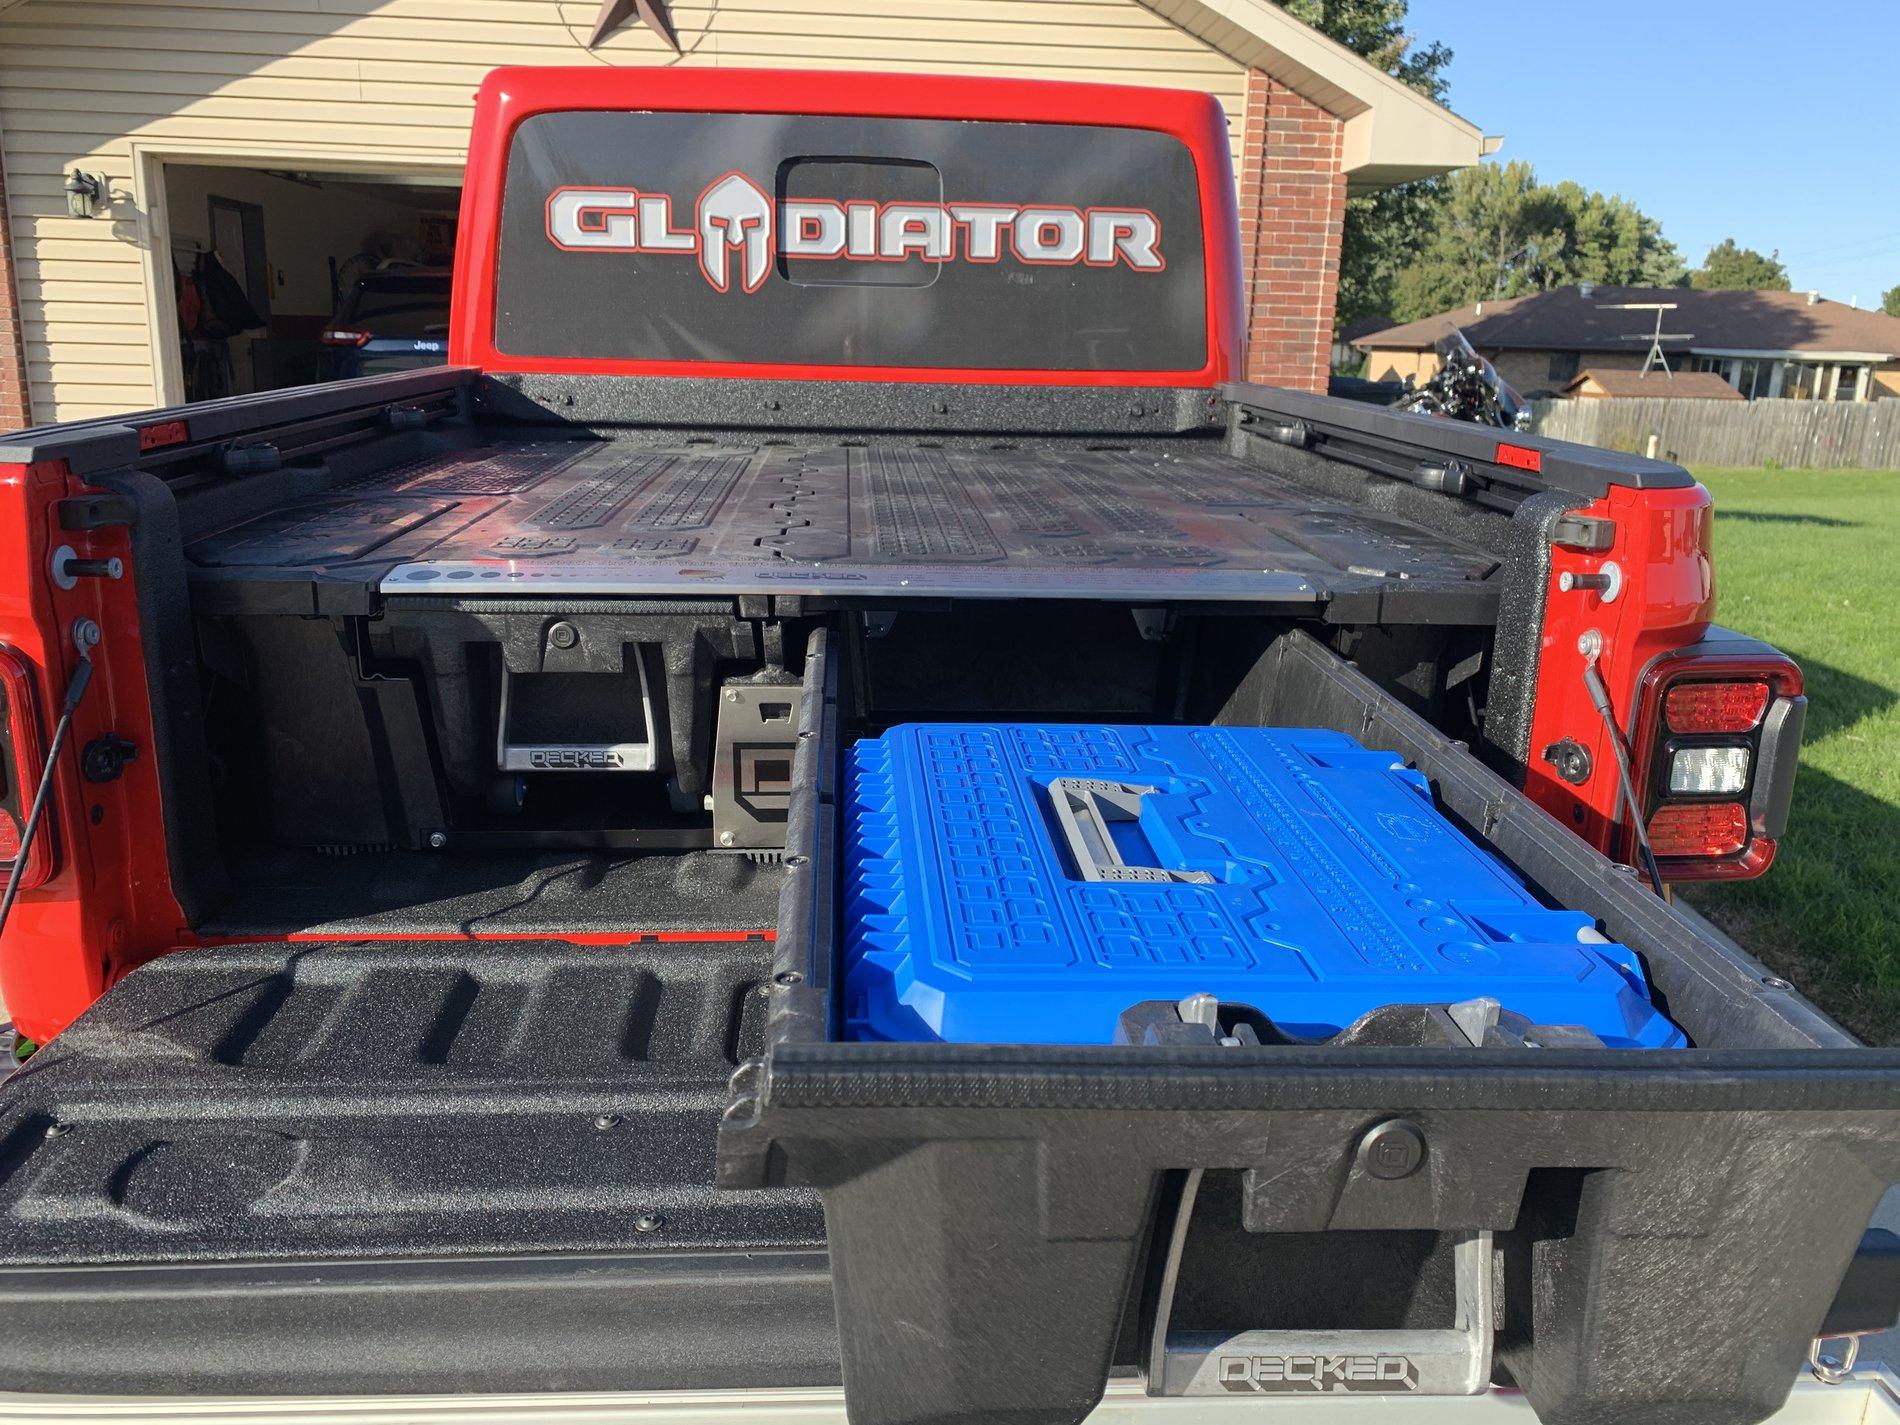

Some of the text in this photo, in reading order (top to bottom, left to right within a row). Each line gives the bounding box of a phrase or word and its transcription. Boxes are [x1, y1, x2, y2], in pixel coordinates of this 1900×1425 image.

[413, 340, 439, 351] Jeep
[530, 751, 624, 768] DECKED
[1218, 1355, 1420, 1392] DECKED
